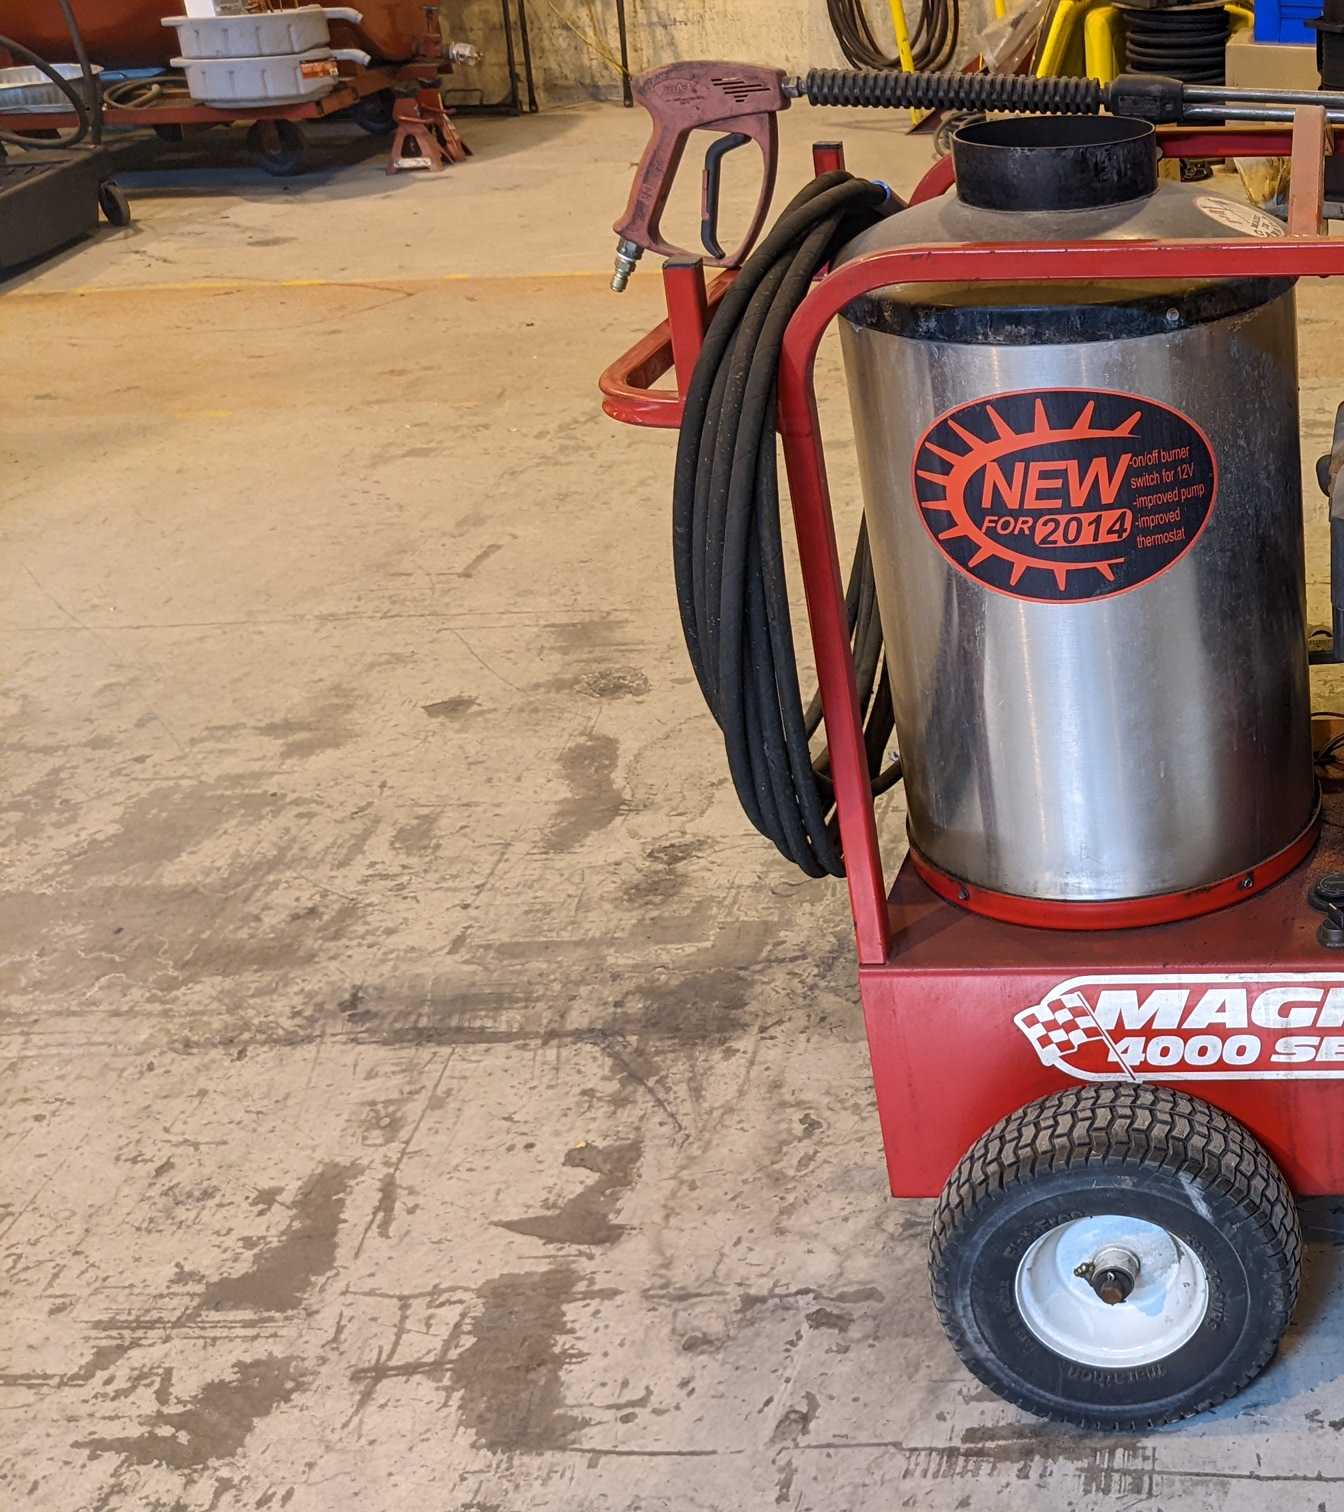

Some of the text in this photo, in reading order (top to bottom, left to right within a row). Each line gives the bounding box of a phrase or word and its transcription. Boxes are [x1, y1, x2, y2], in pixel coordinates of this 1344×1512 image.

[1160, 446, 1190, 463] burner
[981, 453, 1133, 509] NEW
[1130, 462, 1194, 489] switch for 12V
[1132, 482, 1205, 509] -improved pump
[981, 510, 1129, 546] FOR 2014
[1135, 506, 1181, 530] -improved
[1136, 526, 1186, 549] thermostat
[1107, 1034, 1262, 1067] 4000
